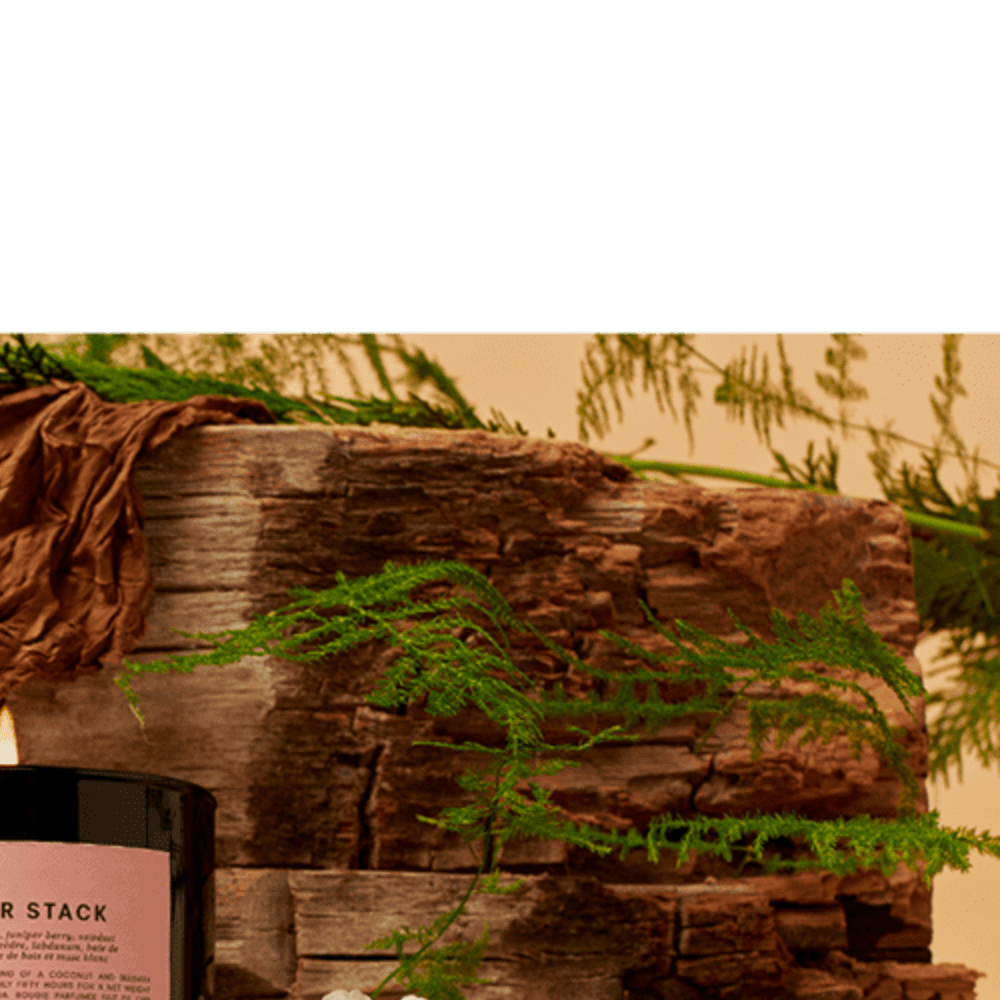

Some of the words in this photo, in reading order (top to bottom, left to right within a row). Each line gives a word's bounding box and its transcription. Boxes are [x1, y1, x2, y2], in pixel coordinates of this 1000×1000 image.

[27, 901, 107, 922] STACK
[108, 944, 119, 953] de
[6, 951, 18, 960] de
[19, 970, 31, 979] OF
[37, 971, 44, 979] A
[48, 970, 93, 980] COCONUT
[98, 972, 116, 982] AND
[98, 982, 104, 991] A
